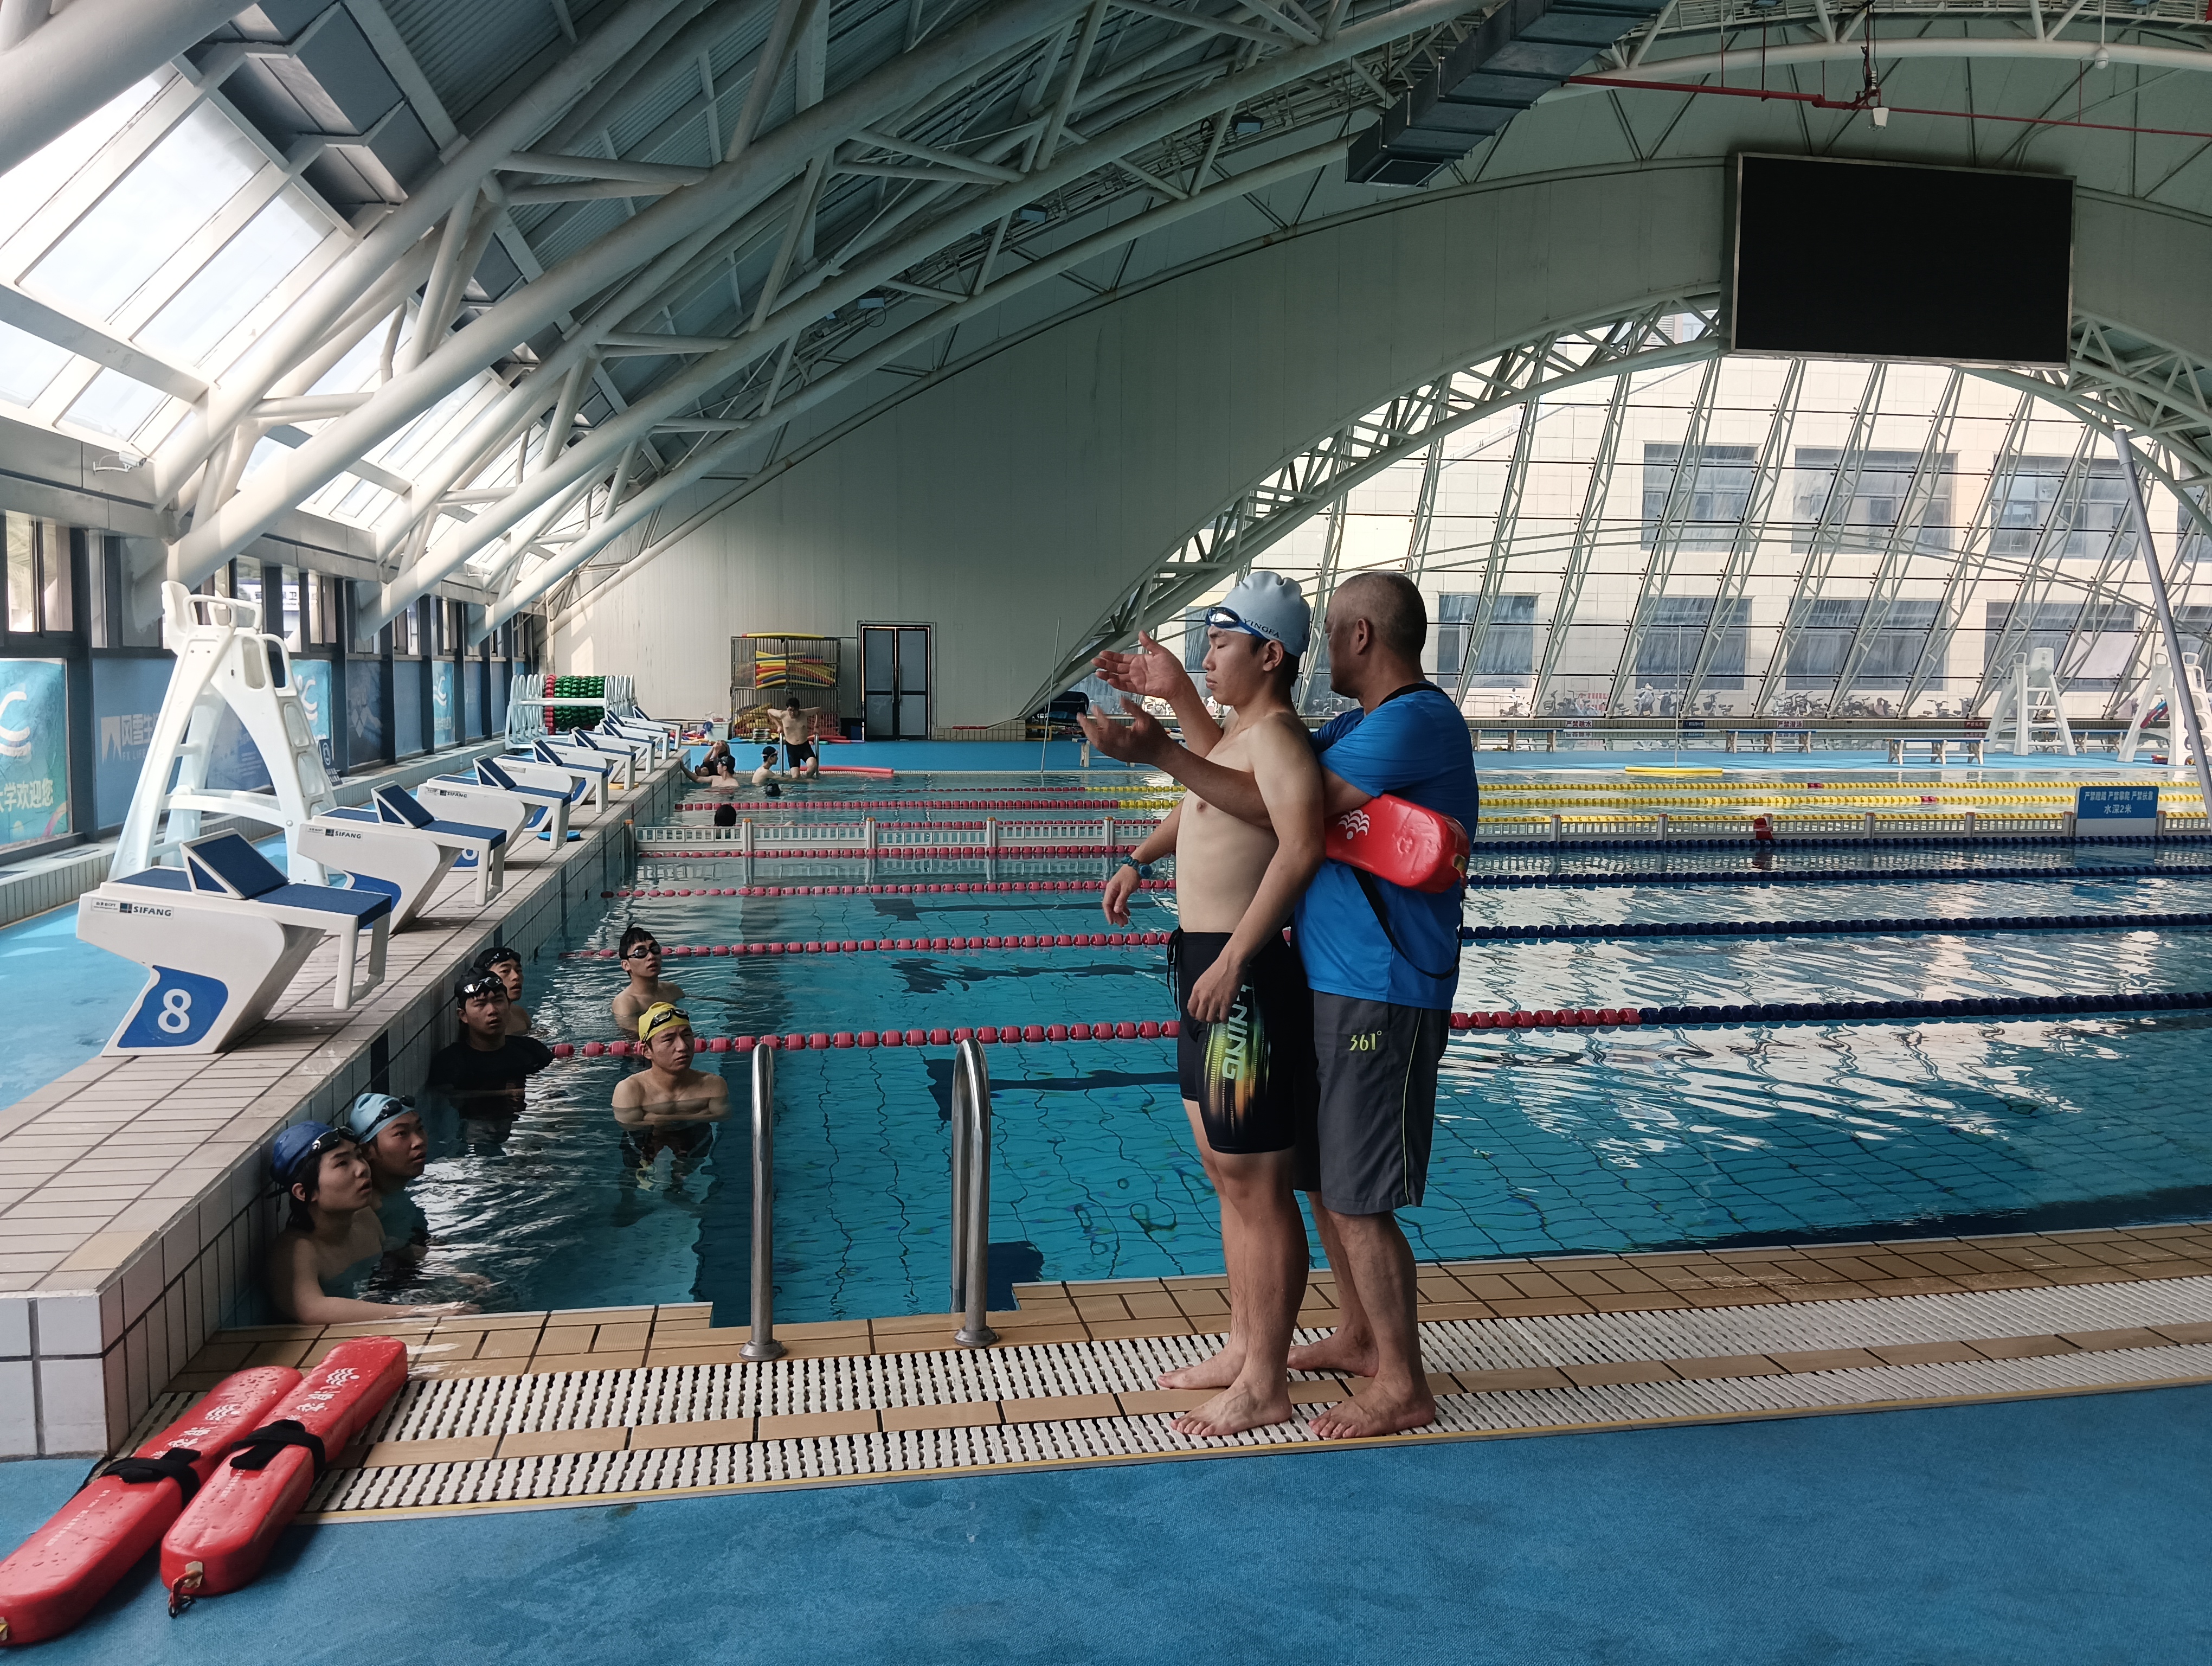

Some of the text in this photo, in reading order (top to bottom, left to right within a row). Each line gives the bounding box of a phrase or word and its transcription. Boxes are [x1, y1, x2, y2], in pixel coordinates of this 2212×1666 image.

[2104, 804, 2132, 814] 水深2米
[335, 831, 361, 839] SIFANG
[133, 906, 171, 917] SIFANG
[157, 989, 192, 1034] 8
[1222, 985, 1250, 1080] NING
